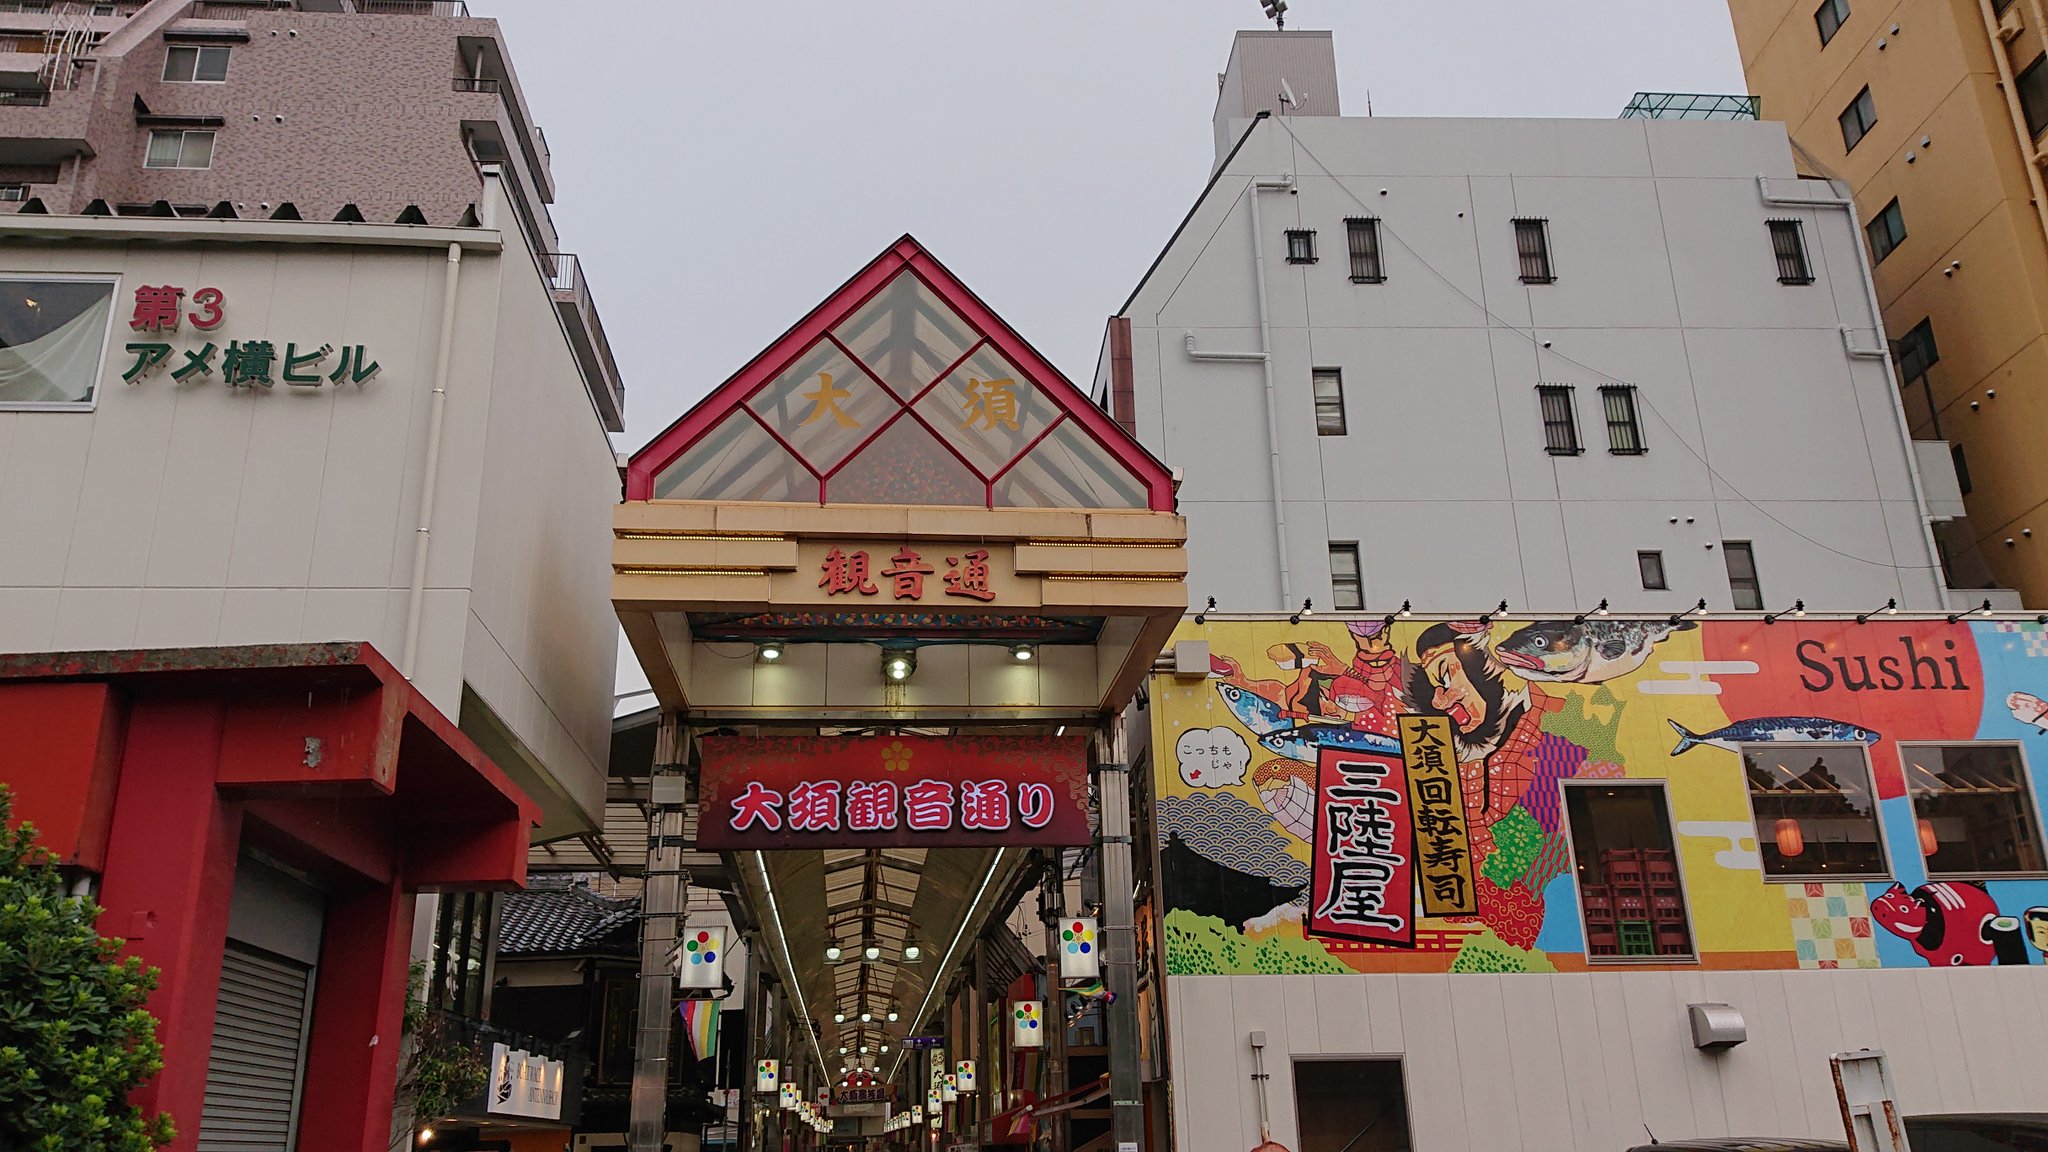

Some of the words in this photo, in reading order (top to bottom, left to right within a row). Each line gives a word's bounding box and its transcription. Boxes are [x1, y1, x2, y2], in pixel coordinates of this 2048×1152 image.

[129, 285, 226, 330] 第3
[122, 339, 381, 388] アメ横ビル
[800, 372, 1020, 432] 大須
[818, 545, 997, 602] 観音通
[1795, 636, 1970, 692] Sushi
[1183, 744, 1232, 756] こっちも
[729, 779, 1056, 832] 大須観音通り
[1409, 719, 1467, 910] 大須回転寿司
[1315, 760, 1405, 932] 三陸屋
